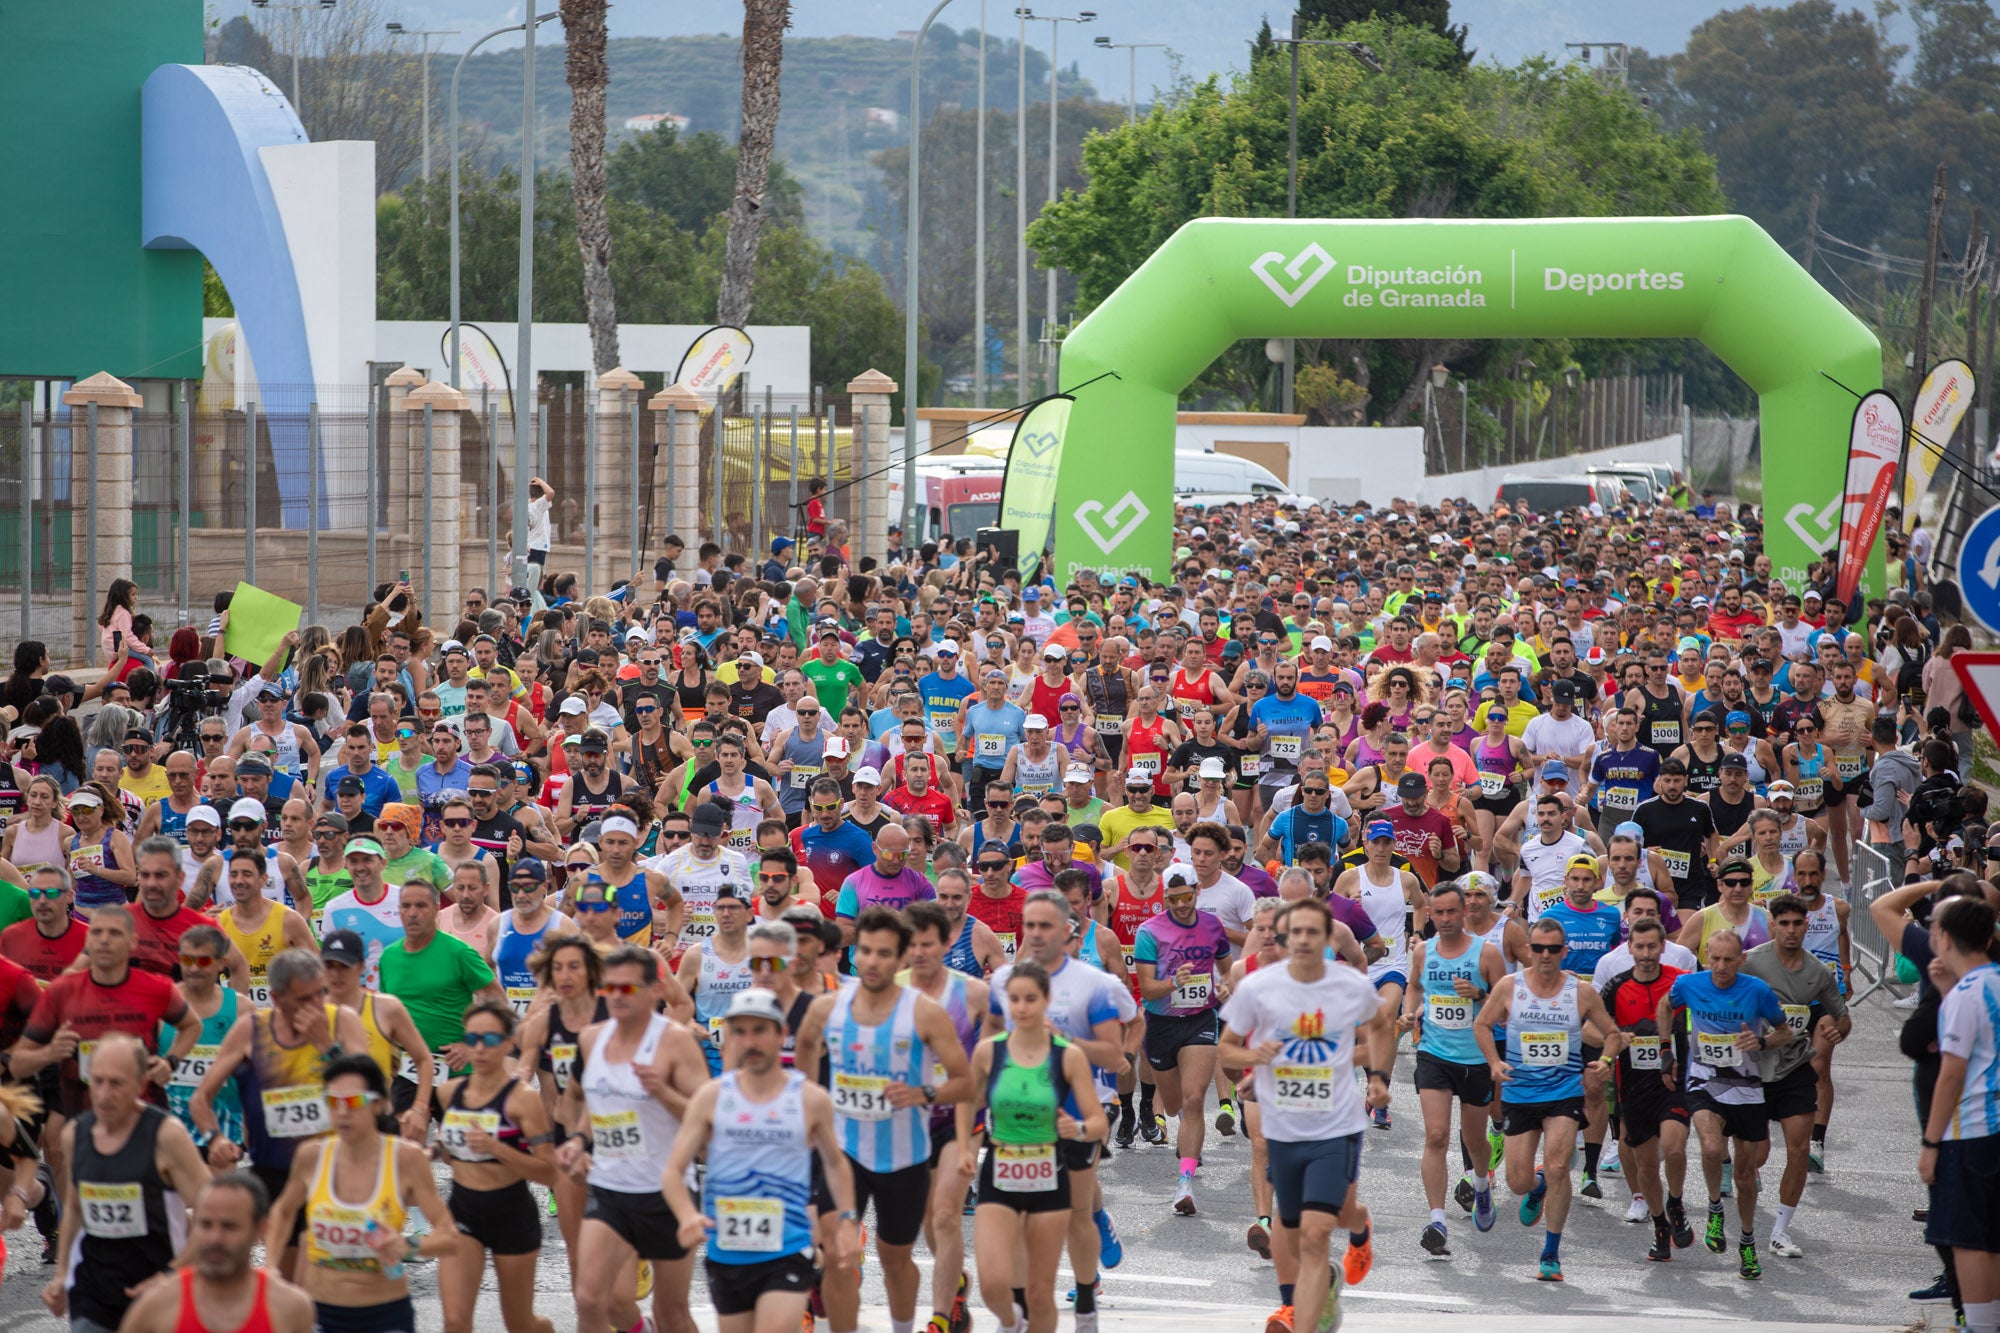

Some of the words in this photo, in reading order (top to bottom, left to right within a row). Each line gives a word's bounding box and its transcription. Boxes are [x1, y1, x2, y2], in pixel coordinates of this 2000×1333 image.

[1346, 263, 1482, 289] Diputación
[1544, 267, 1685, 295] Deportes
[1342, 288, 1373, 308] de
[1379, 289, 1487, 308] Granada
[1923, 376, 1958, 426] Cruzcampo
[1015, 459, 1056, 472] Diputación
[1007, 507, 1052, 521] Deportes
[1100, 721, 1119, 730] 159
[1653, 729, 1679, 738] 3008
[984, 741, 998, 750] 28
[1275, 743, 1296, 753] 732
[1136, 759, 1157, 770] 200
[1021, 771, 1054, 780] MARACENA
[1607, 793, 1635, 806] 3281
[685, 924, 716, 937] 442
[1178, 985, 1208, 1000] 158
[1435, 1007, 1466, 1021] 509
[1519, 1011, 1570, 1022] MARACENA
[1528, 1044, 1562, 1058] 533
[1703, 1044, 1733, 1059] 851
[1277, 1080, 1331, 1099] 3245
[835, 1089, 886, 1111] 3131
[274, 1103, 320, 1124] 738
[997, 1161, 1053, 1180] 2008
[725, 1216, 771, 1238] 214
